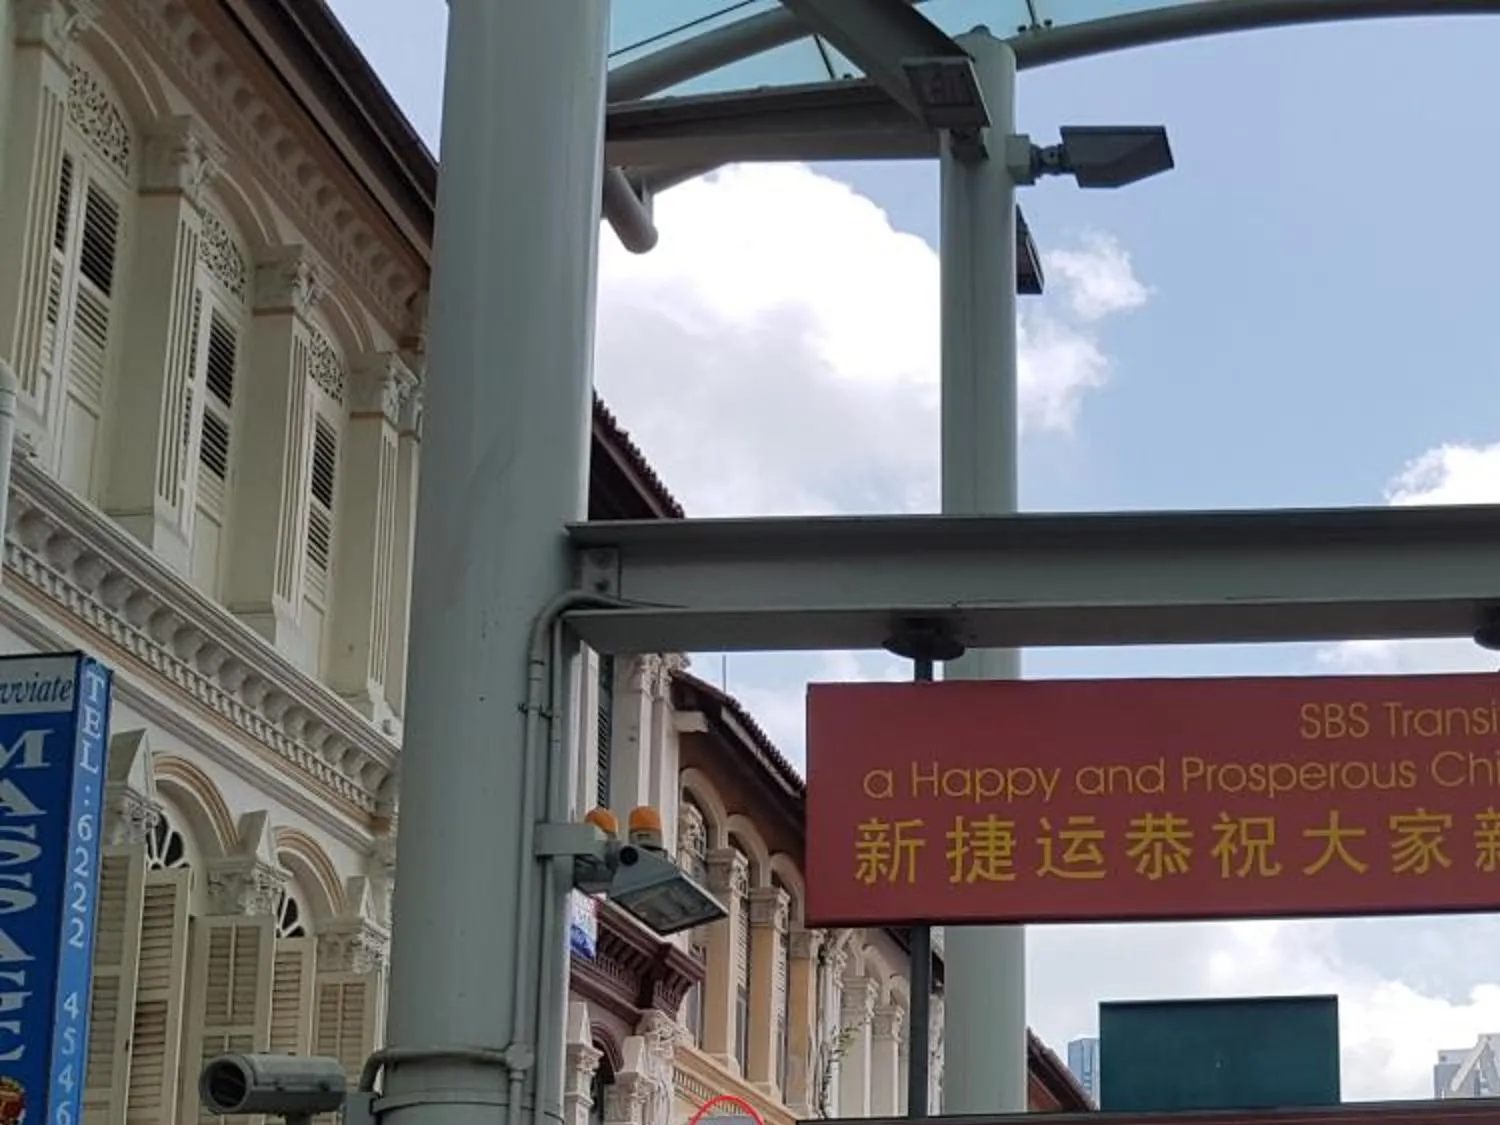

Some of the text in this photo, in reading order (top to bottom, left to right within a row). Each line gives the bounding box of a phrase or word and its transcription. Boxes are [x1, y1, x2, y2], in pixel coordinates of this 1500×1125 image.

[1300, 702, 1369, 739] SBS
[862, 767, 895, 800] a
[911, 759, 1062, 804] Happy
[1074, 757, 1166, 797] and
[1181, 750, 1417, 798] Prosperous
